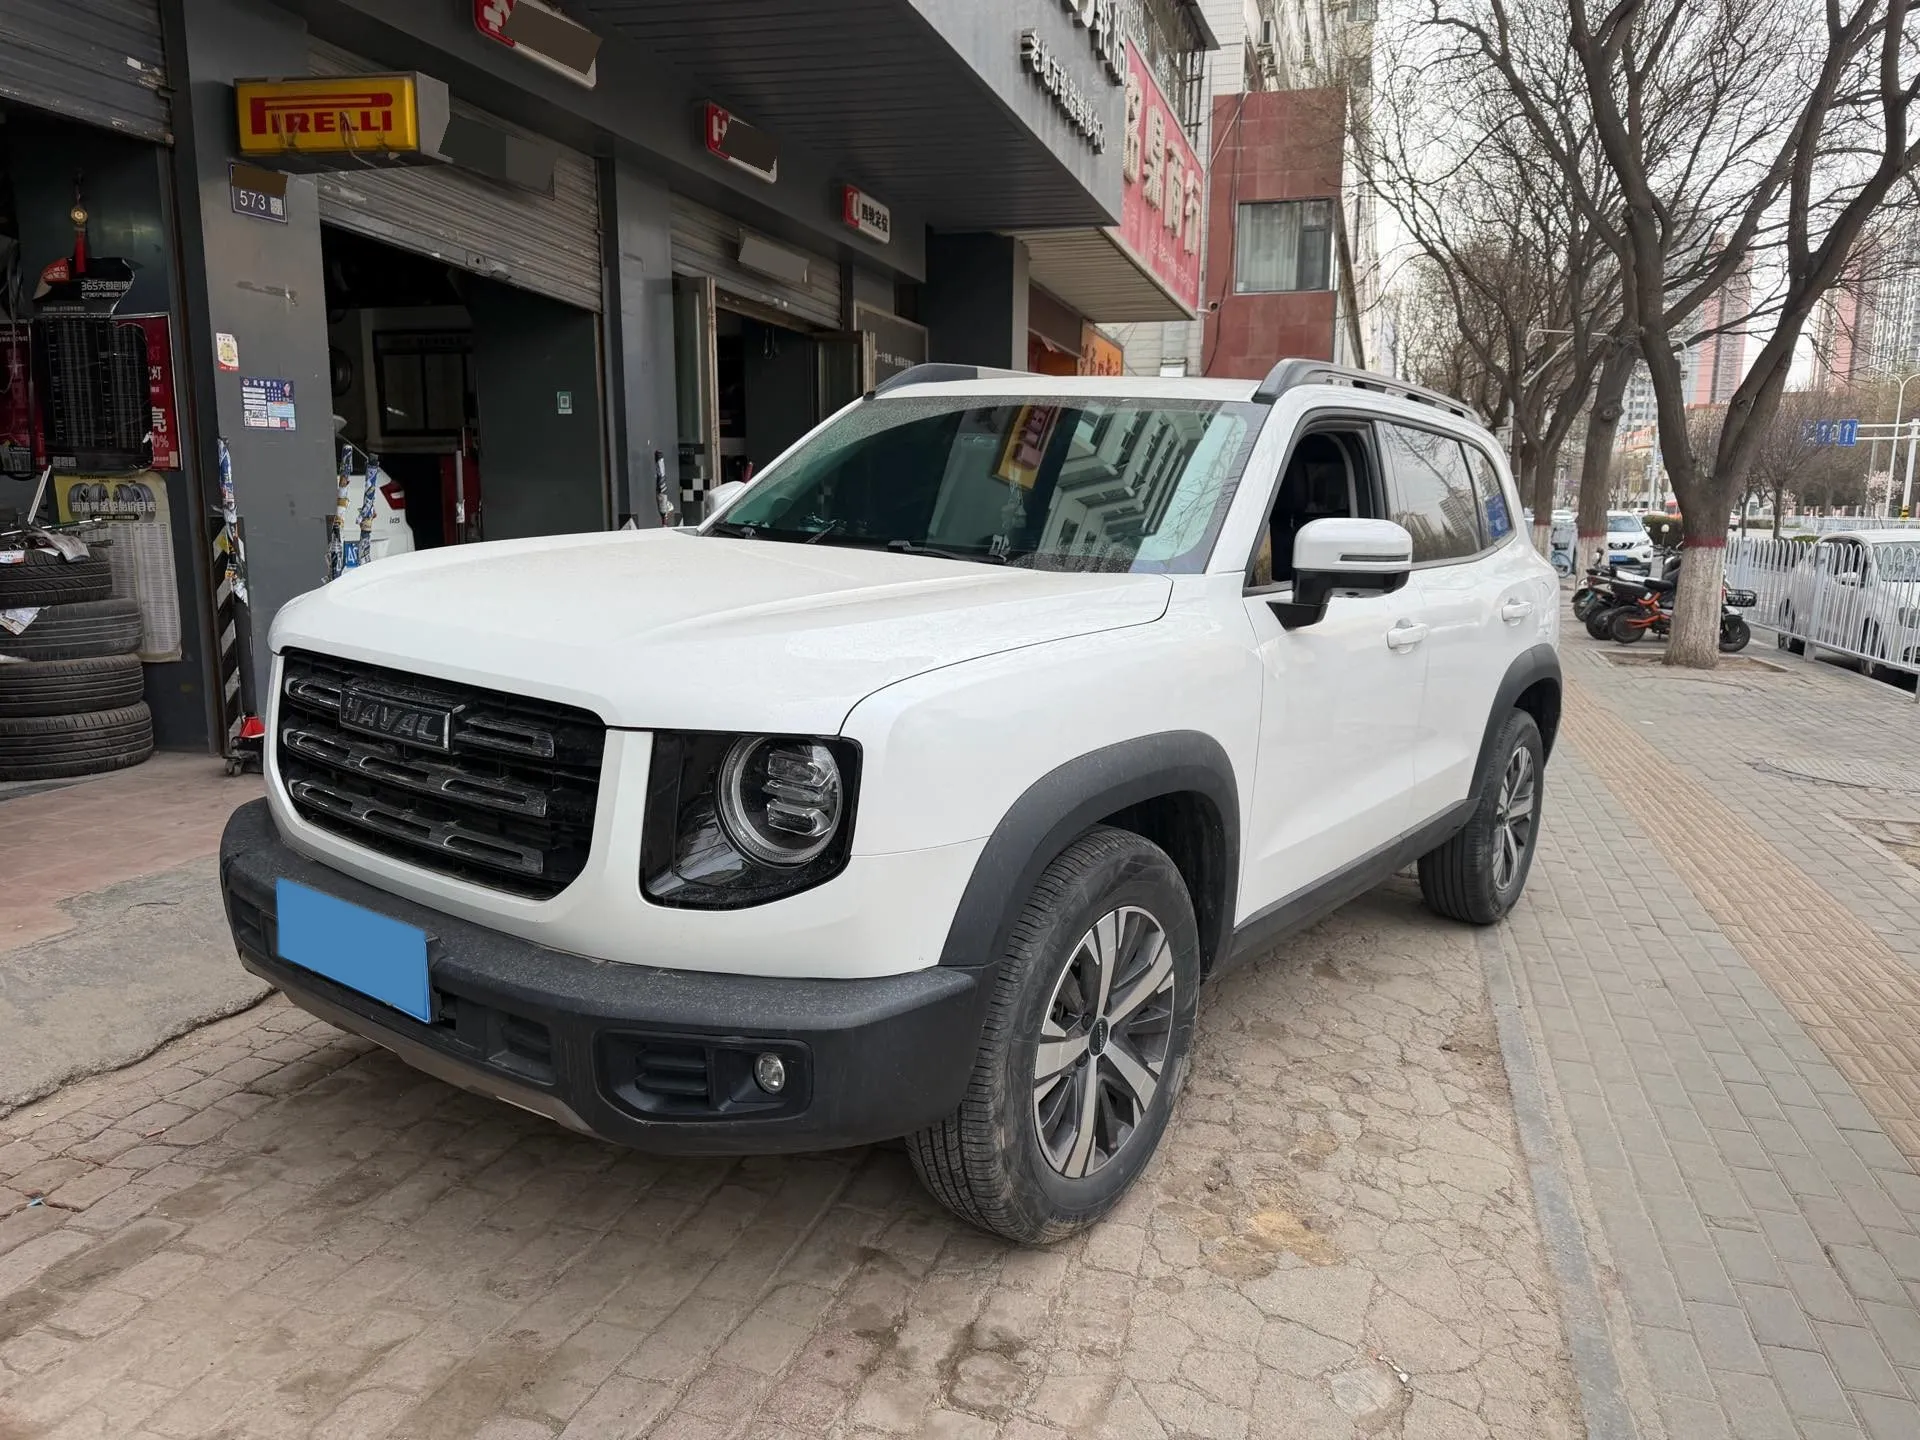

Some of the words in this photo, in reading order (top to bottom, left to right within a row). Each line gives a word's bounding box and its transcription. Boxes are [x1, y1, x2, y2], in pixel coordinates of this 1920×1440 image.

[251, 92, 393, 135] PIRELLI
[239, 190, 266, 211] 573
[345, 697, 439, 741] HAVAL
